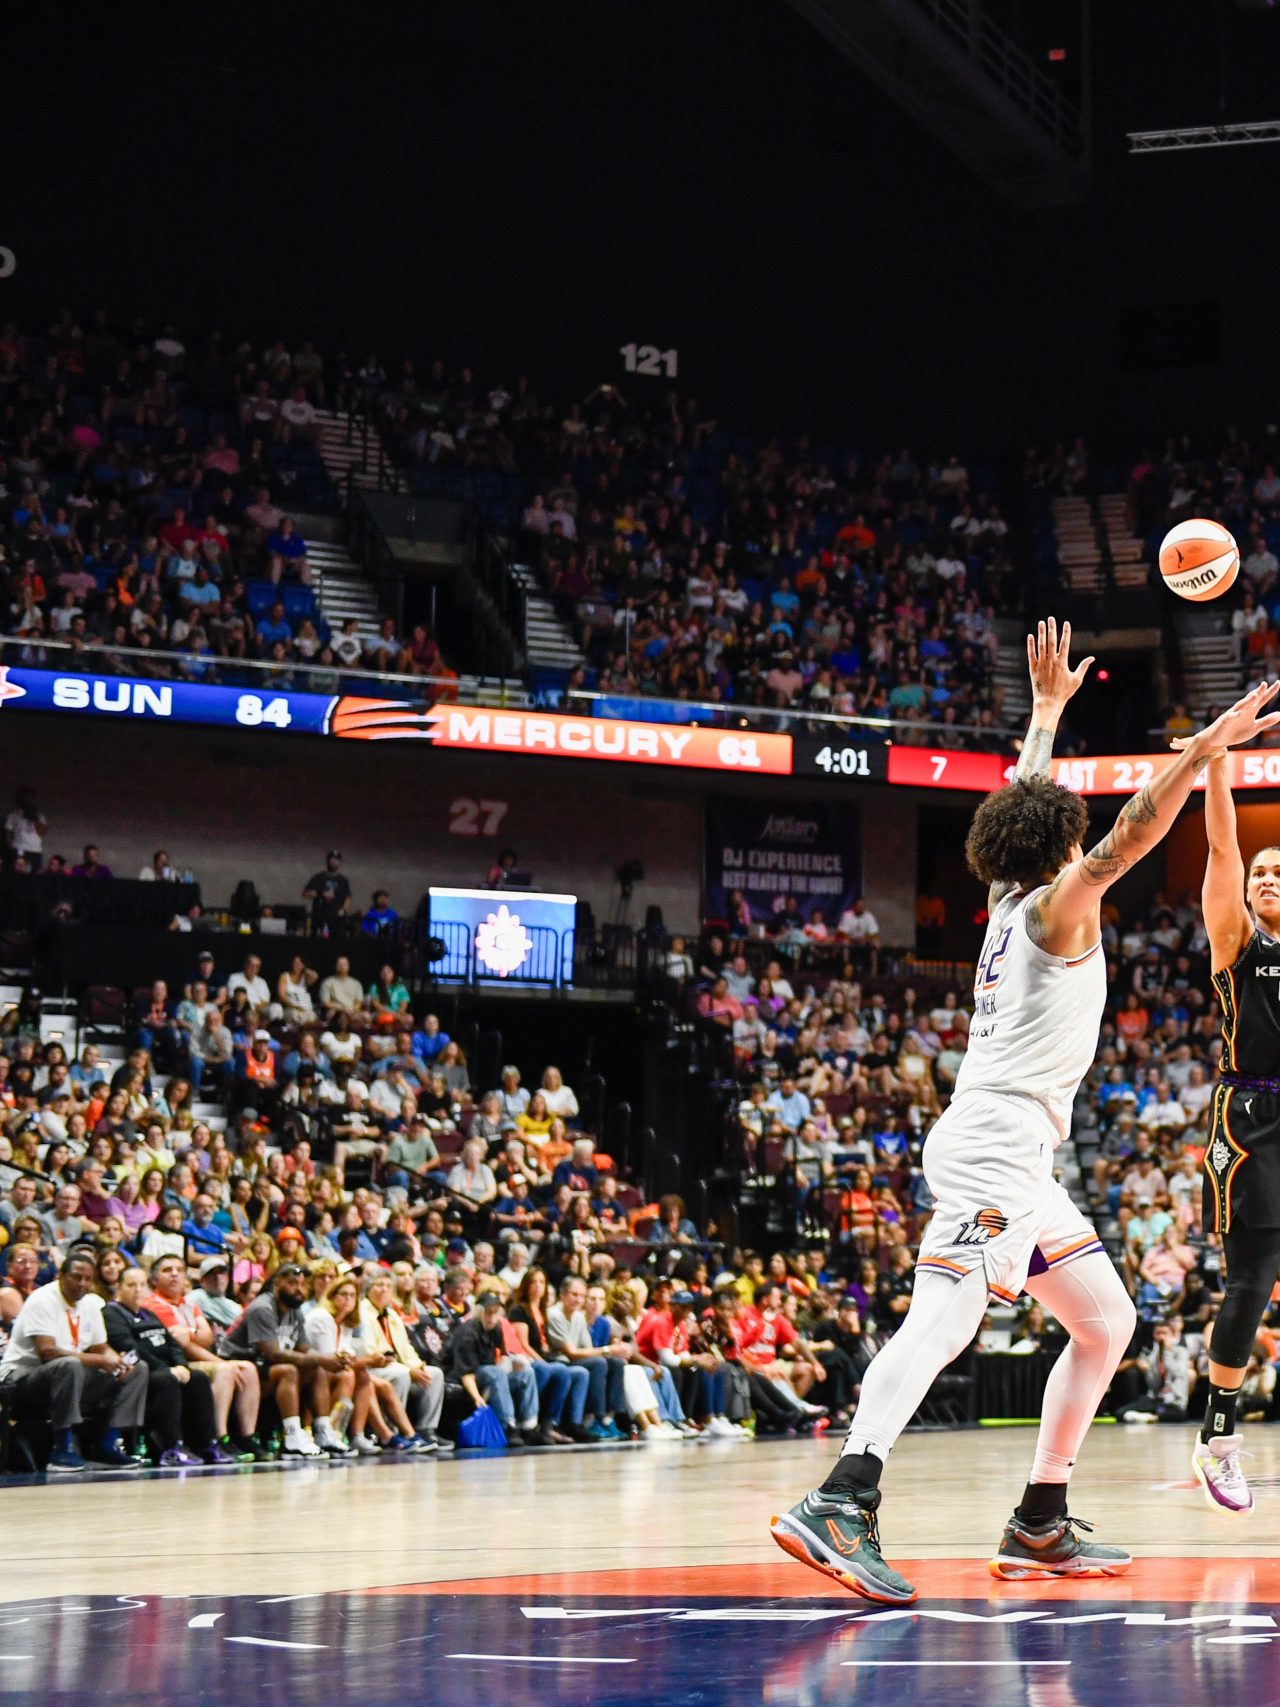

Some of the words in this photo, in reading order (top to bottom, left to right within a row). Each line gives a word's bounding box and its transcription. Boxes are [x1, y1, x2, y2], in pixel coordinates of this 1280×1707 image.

[620, 344, 677, 377] 121
[52, 677, 172, 717] SUN
[236, 694, 291, 728] 84
[448, 713, 692, 761] MERCURY
[718, 736, 762, 768] 61
[815, 747, 870, 776] 4:01
[931, 757, 948, 781] 7
[1057, 761, 1097, 791] AST
[1113, 762, 1154, 789] 22
[449, 799, 508, 835] 27
[723, 848, 743, 867] DJ
[748, 850, 842, 873] EXPERIENCE
